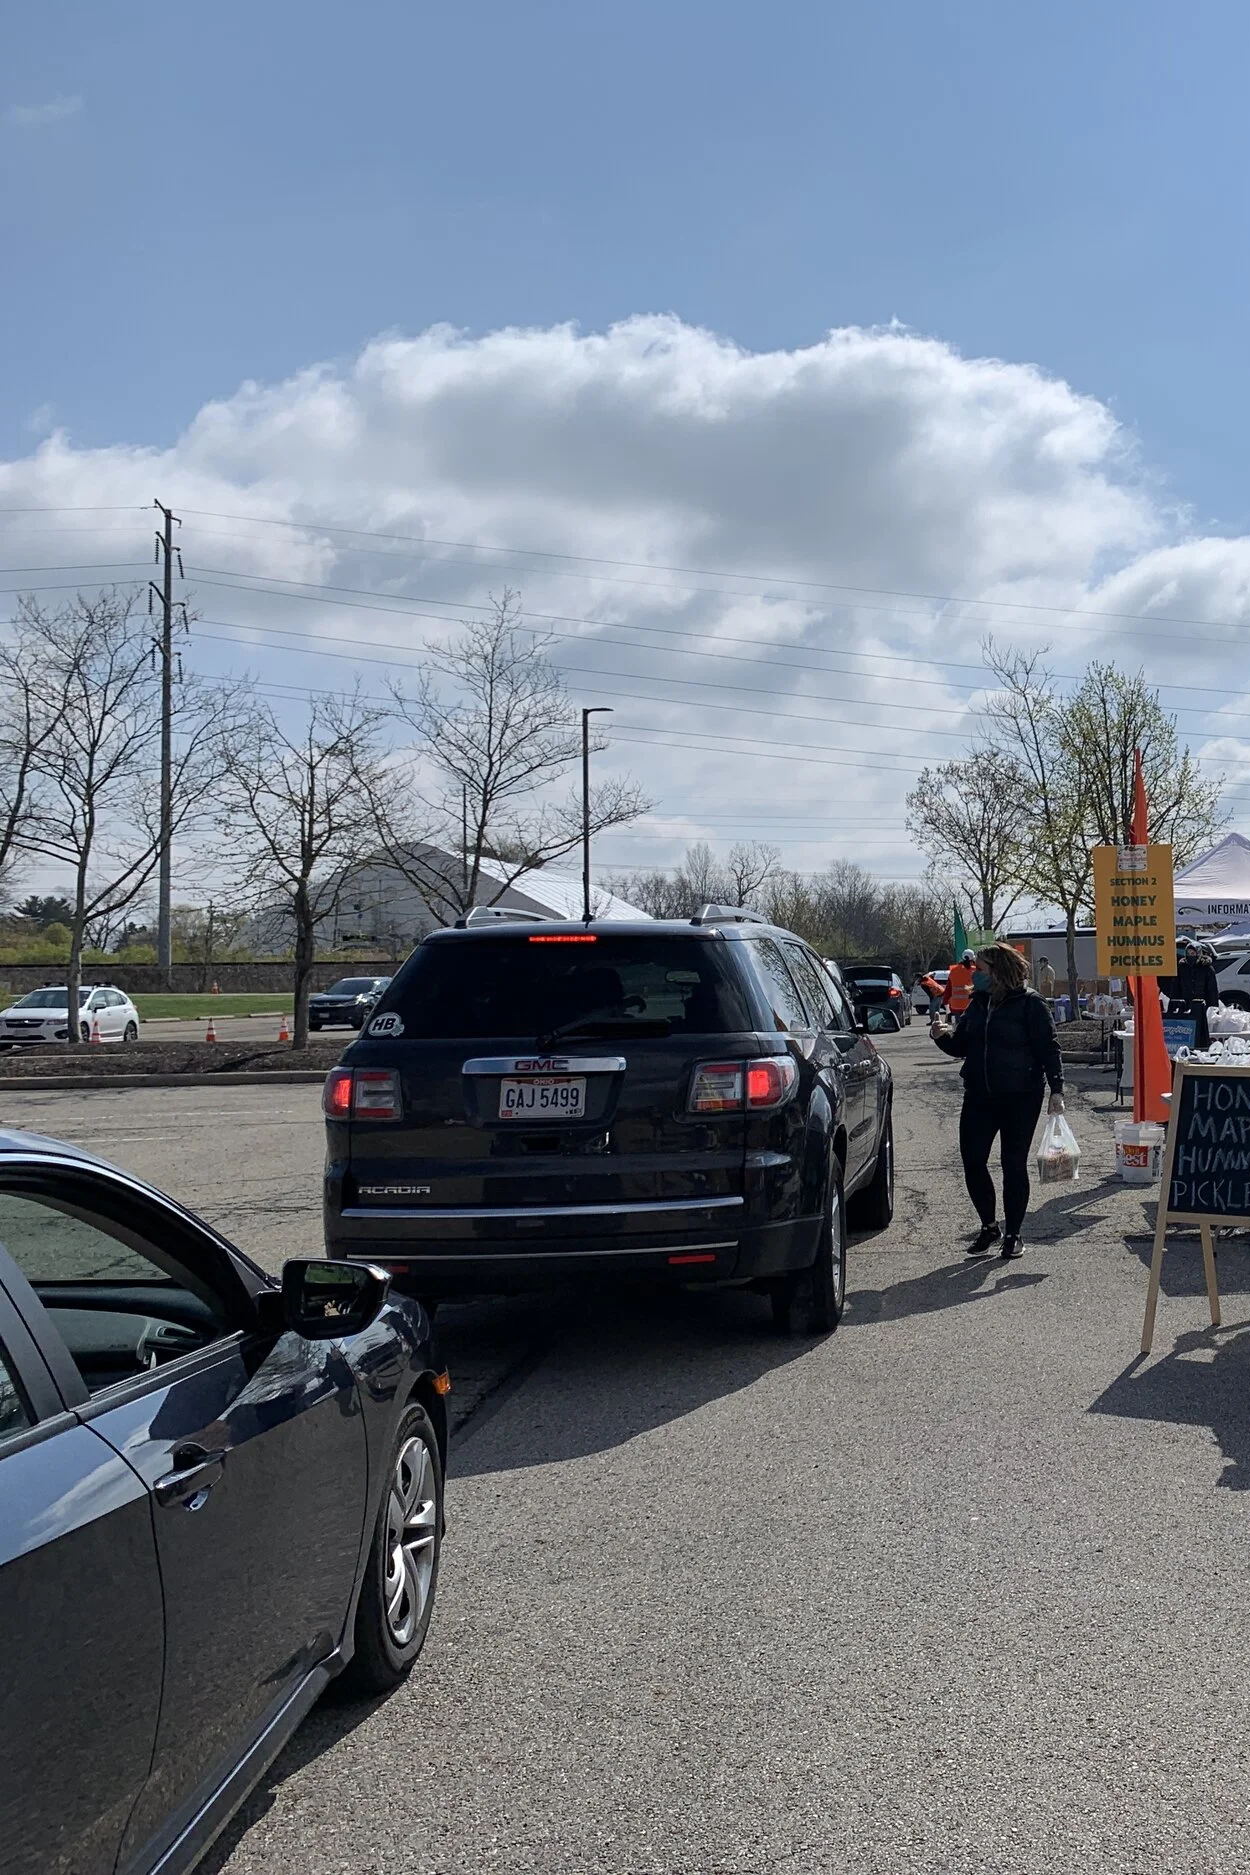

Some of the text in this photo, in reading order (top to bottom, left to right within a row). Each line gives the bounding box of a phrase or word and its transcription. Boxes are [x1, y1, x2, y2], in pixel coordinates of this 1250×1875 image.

[1110, 877, 1157, 886] SECTION 2
[1111, 895, 1157, 907] HONEY
[1113, 915, 1157, 927] MAPLE
[1107, 935, 1165, 947] HUMMUS
[1110, 955, 1163, 967] PICKLES
[372, 1017, 397, 1031] HB
[514, 1059, 569, 1071] GMC
[506, 1087, 580, 1108] GAJ 5499
[358, 1186, 431, 1194] ACADIA
